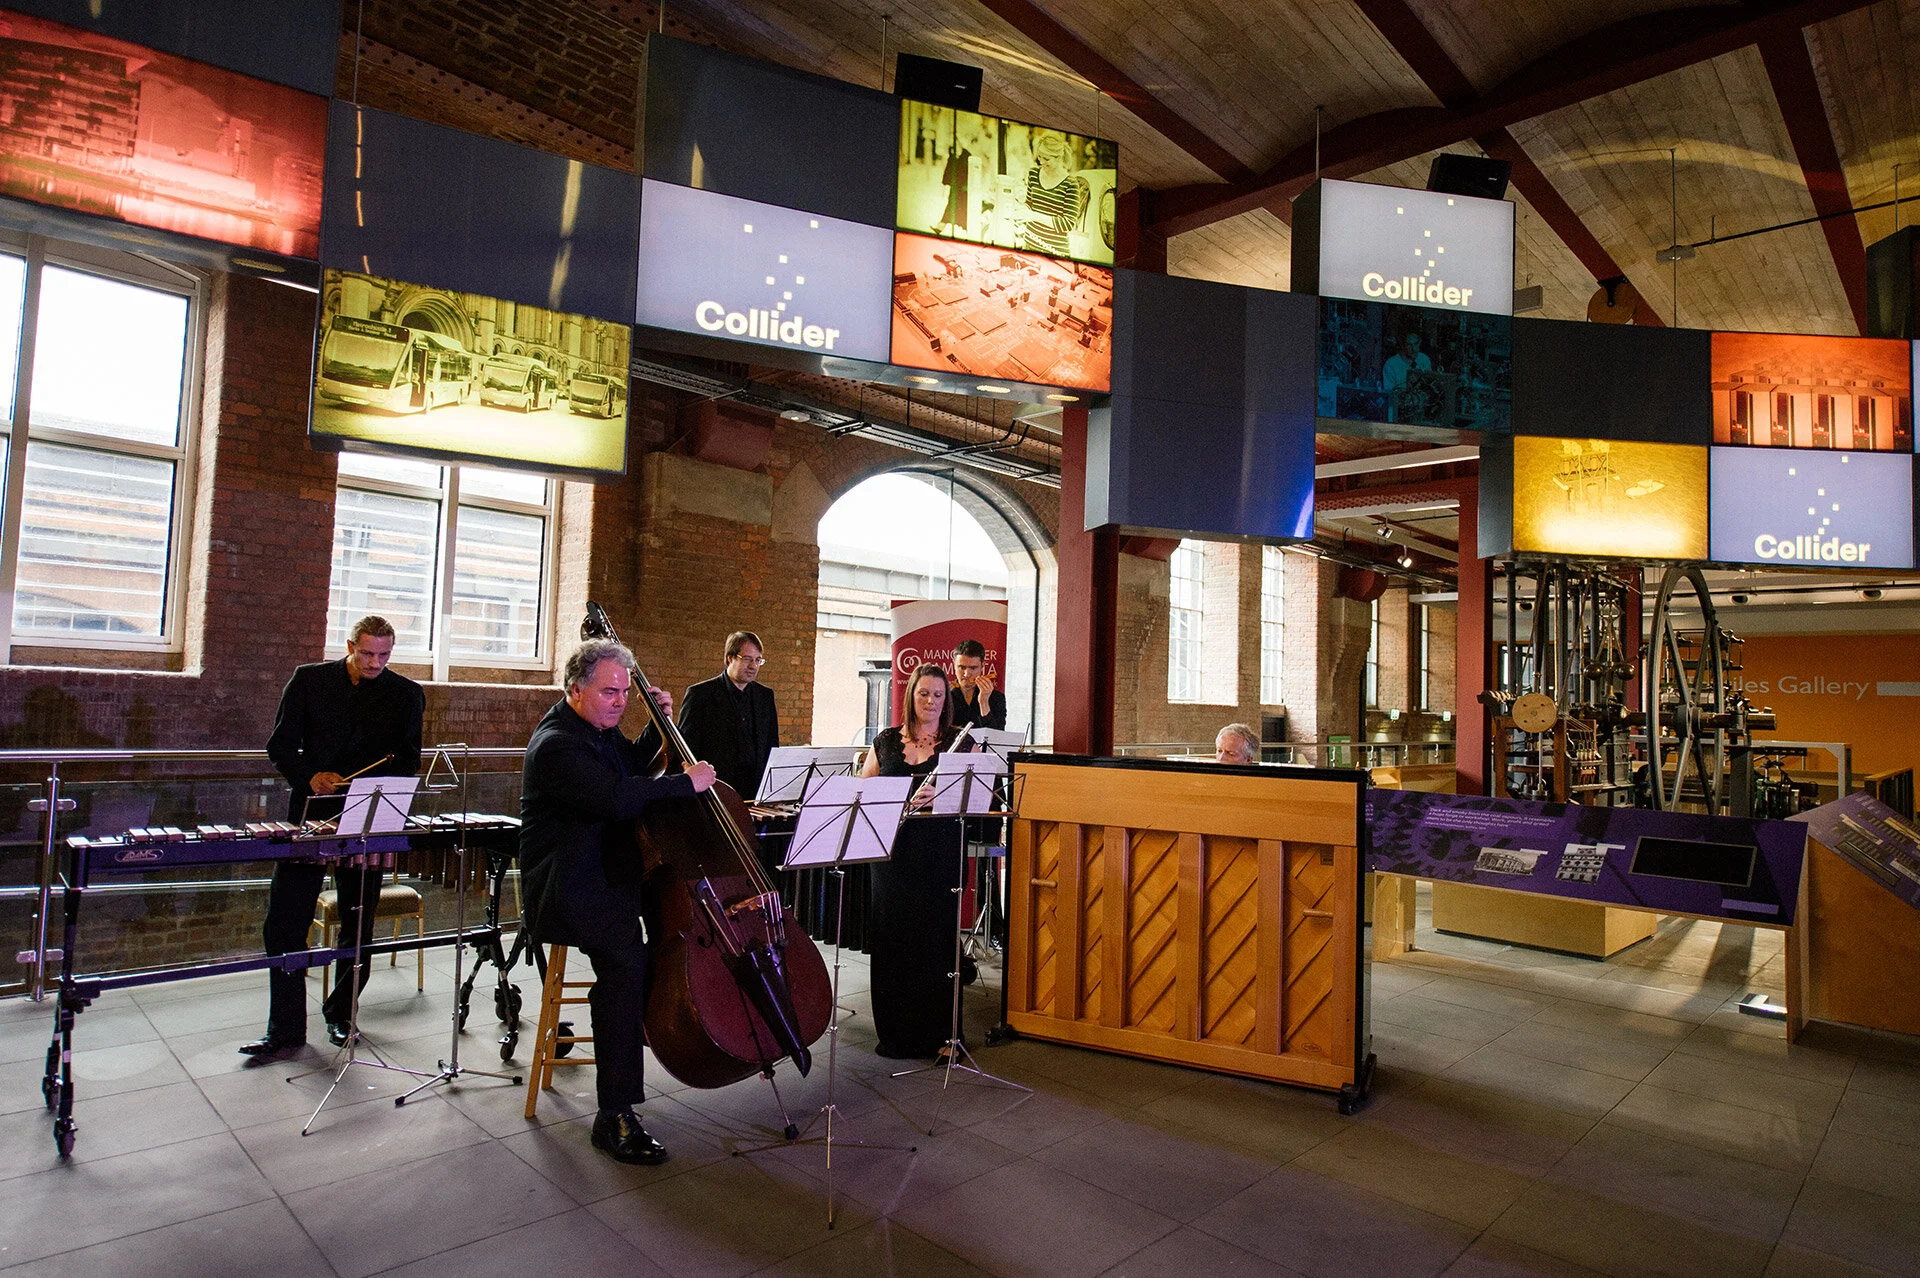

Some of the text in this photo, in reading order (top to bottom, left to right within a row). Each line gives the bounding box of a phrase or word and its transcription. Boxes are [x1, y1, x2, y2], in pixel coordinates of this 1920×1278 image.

[1362, 272, 1473, 307] Collider
[695, 300, 840, 350] Collider
[1754, 534, 1871, 562] Collider
[1777, 675, 1870, 700] Gallery
